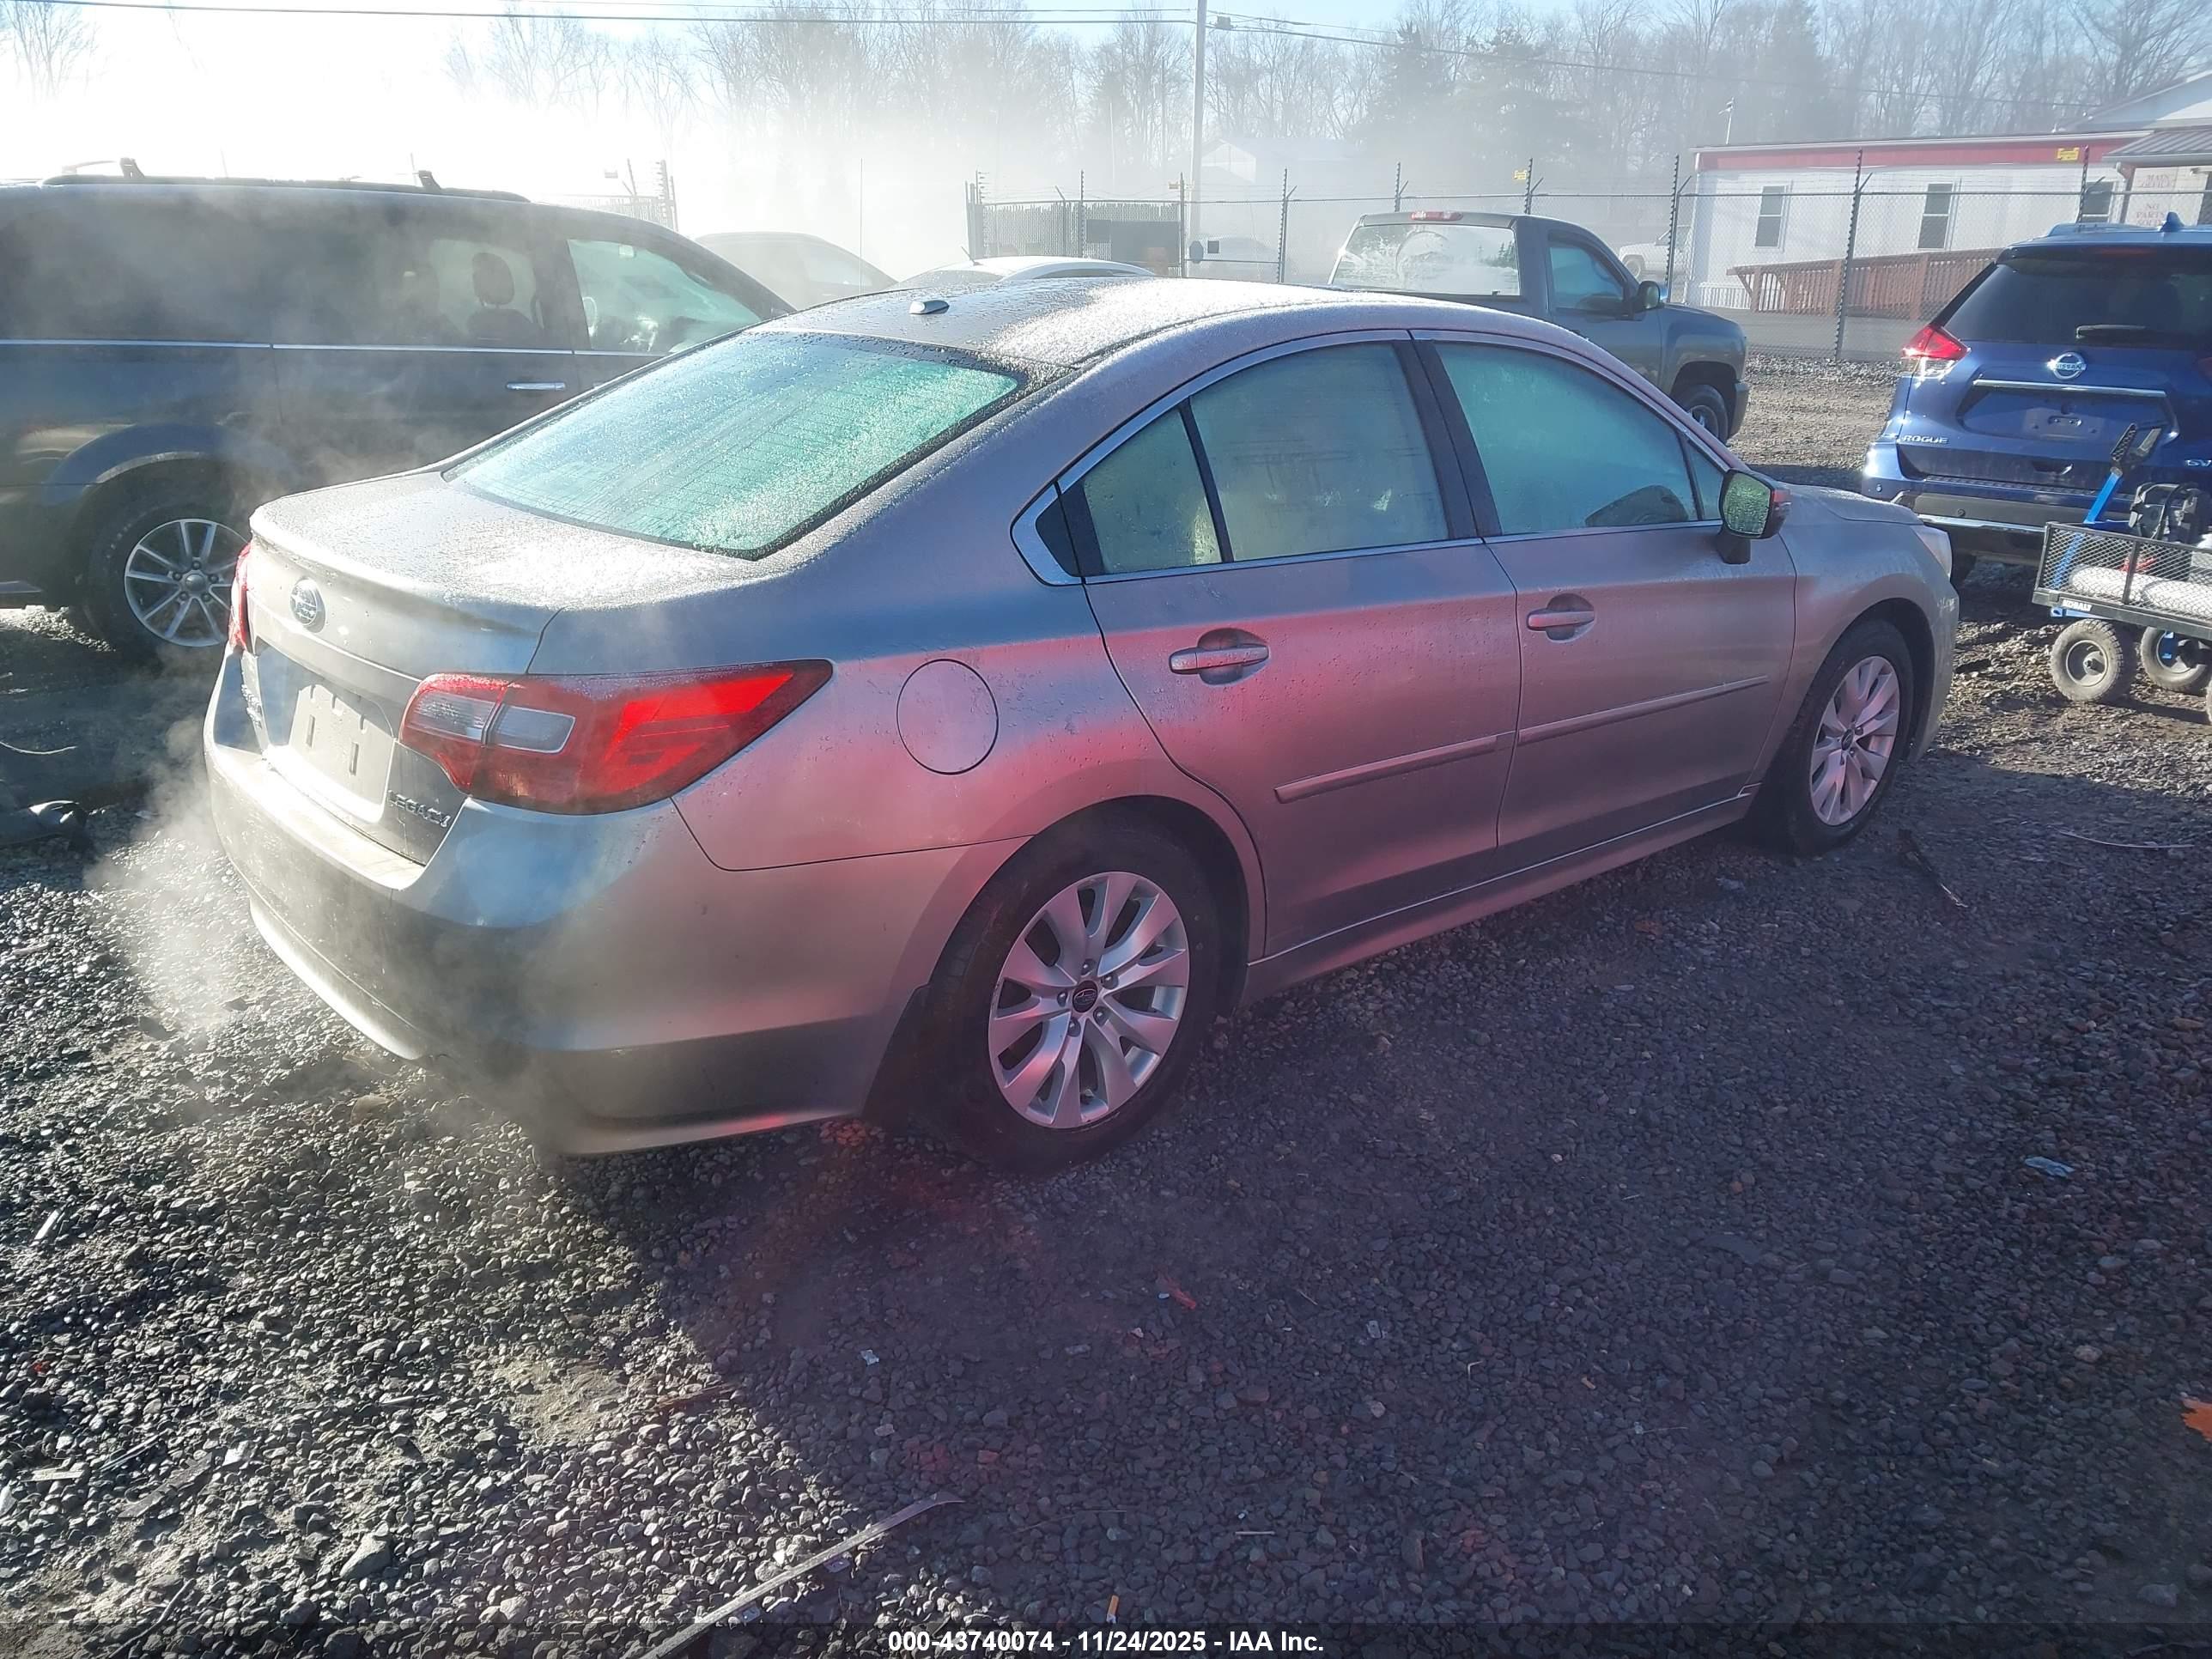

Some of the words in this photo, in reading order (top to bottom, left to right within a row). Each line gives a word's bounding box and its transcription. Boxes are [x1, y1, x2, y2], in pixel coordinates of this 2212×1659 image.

[1901, 434, 1949, 445] ROGUE
[2062, 599, 2093, 612] KOBALT
[387, 789, 452, 829] LEGACY
